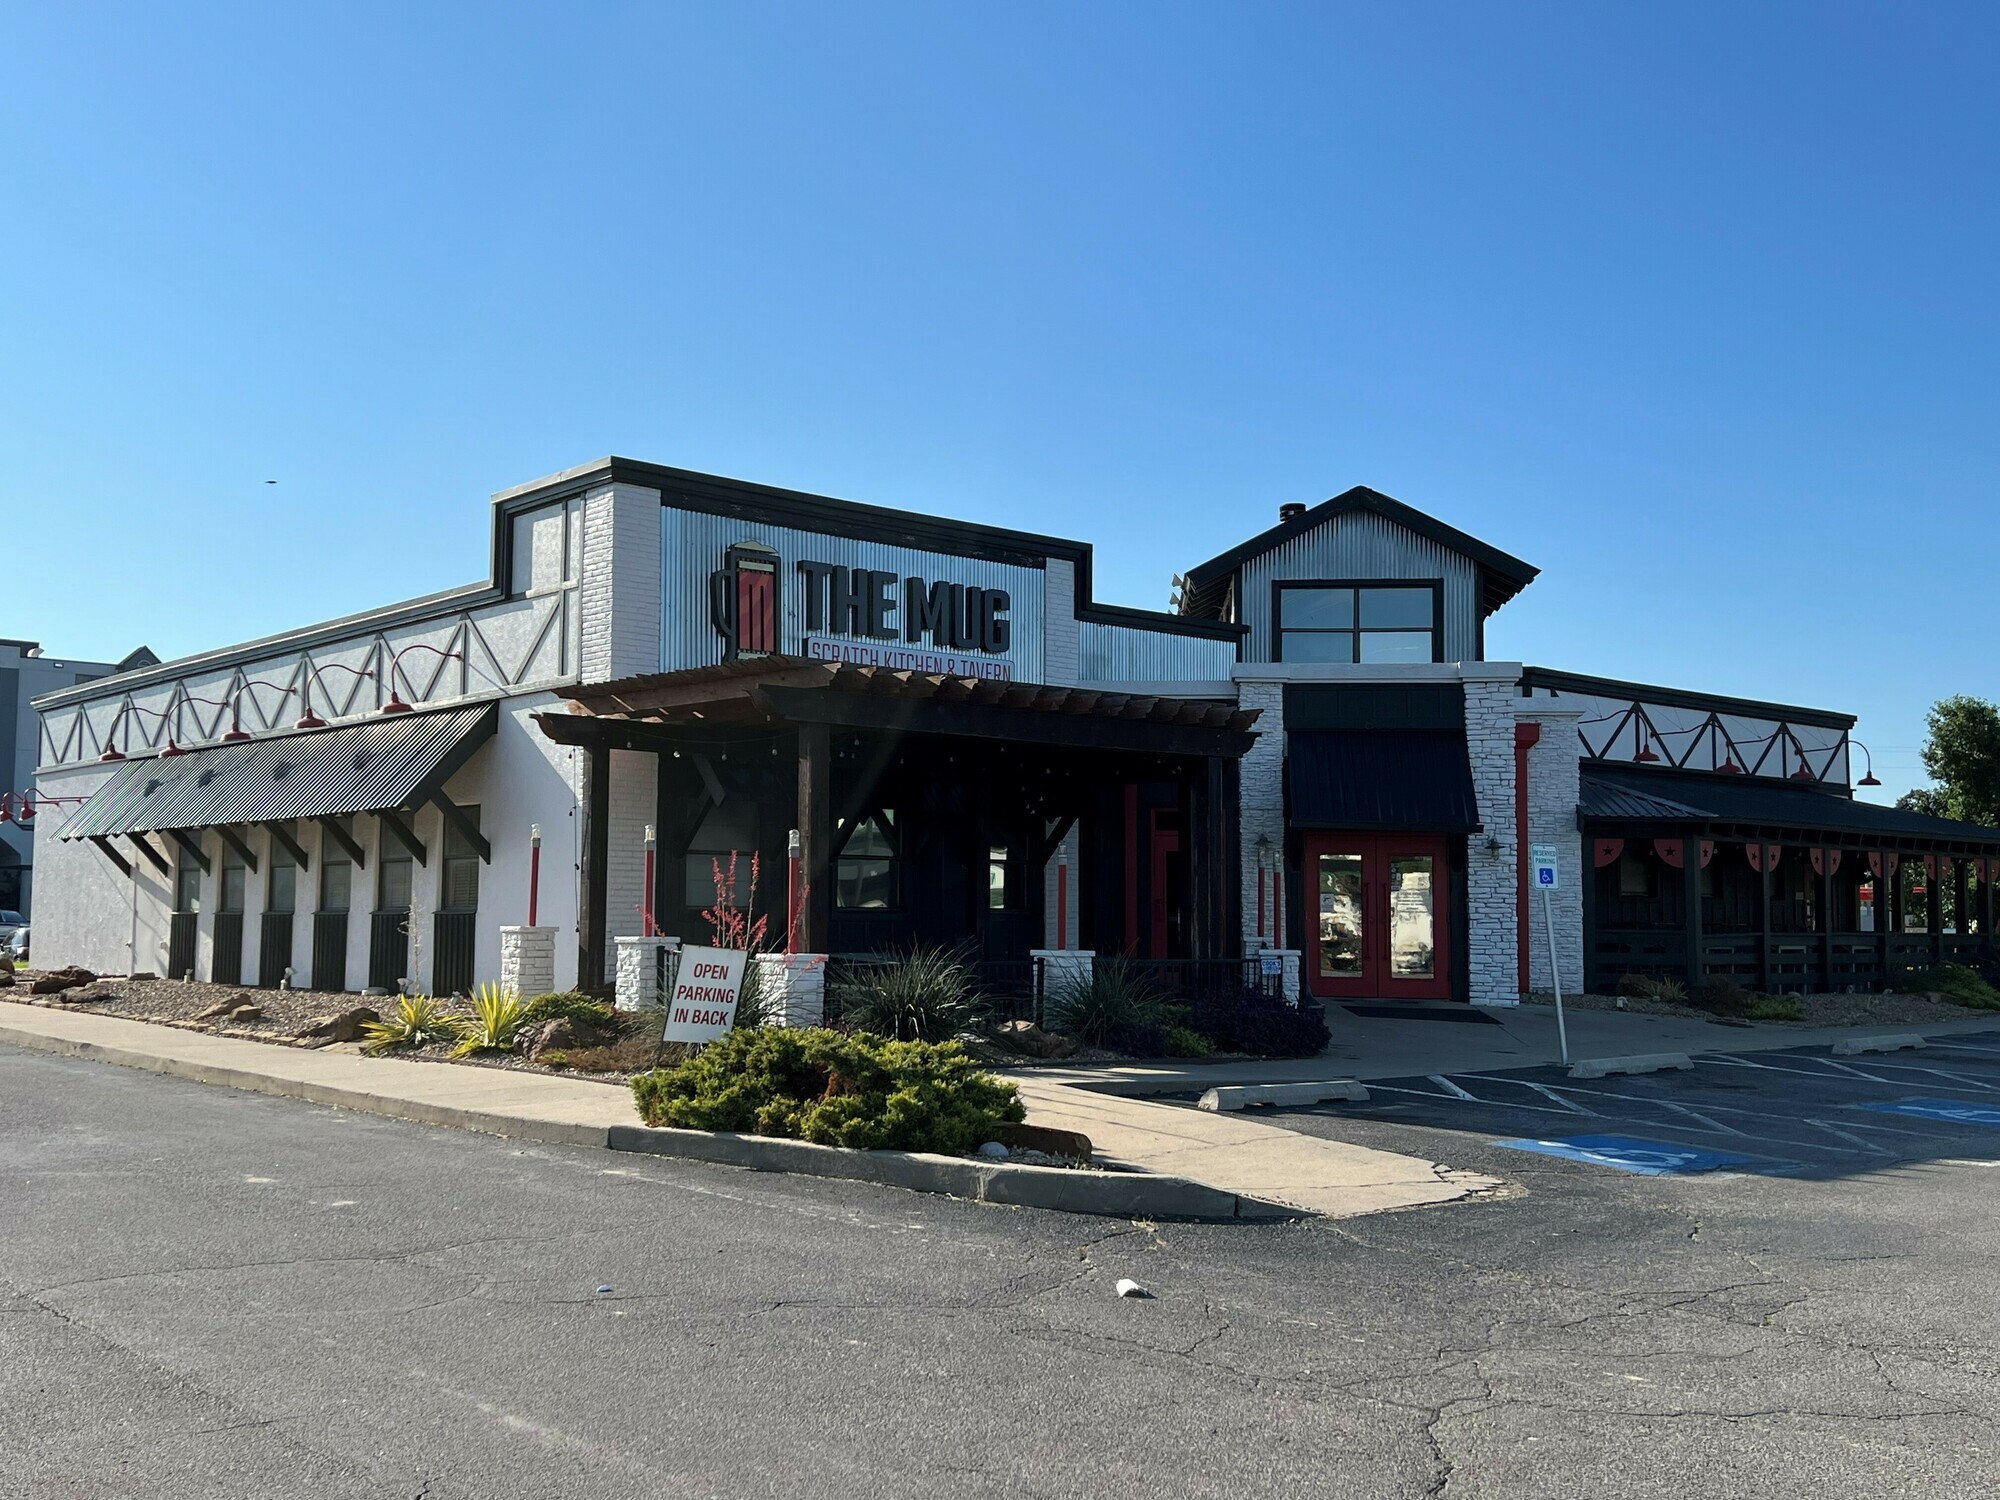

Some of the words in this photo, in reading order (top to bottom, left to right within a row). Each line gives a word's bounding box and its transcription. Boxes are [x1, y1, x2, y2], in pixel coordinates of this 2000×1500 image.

[798, 560, 898, 639] THE
[907, 577, 1010, 653] MUG
[812, 642, 878, 666] SCRATCH
[884, 650, 942, 674] KITCHEN
[948, 659, 957, 676] &
[961, 660, 1011, 682] TAVERN
[693, 963, 729, 980] OPEN
[677, 985, 735, 1004] PARKING
[674, 1008, 689, 1024] IN
[692, 1009, 729, 1026] BACK
